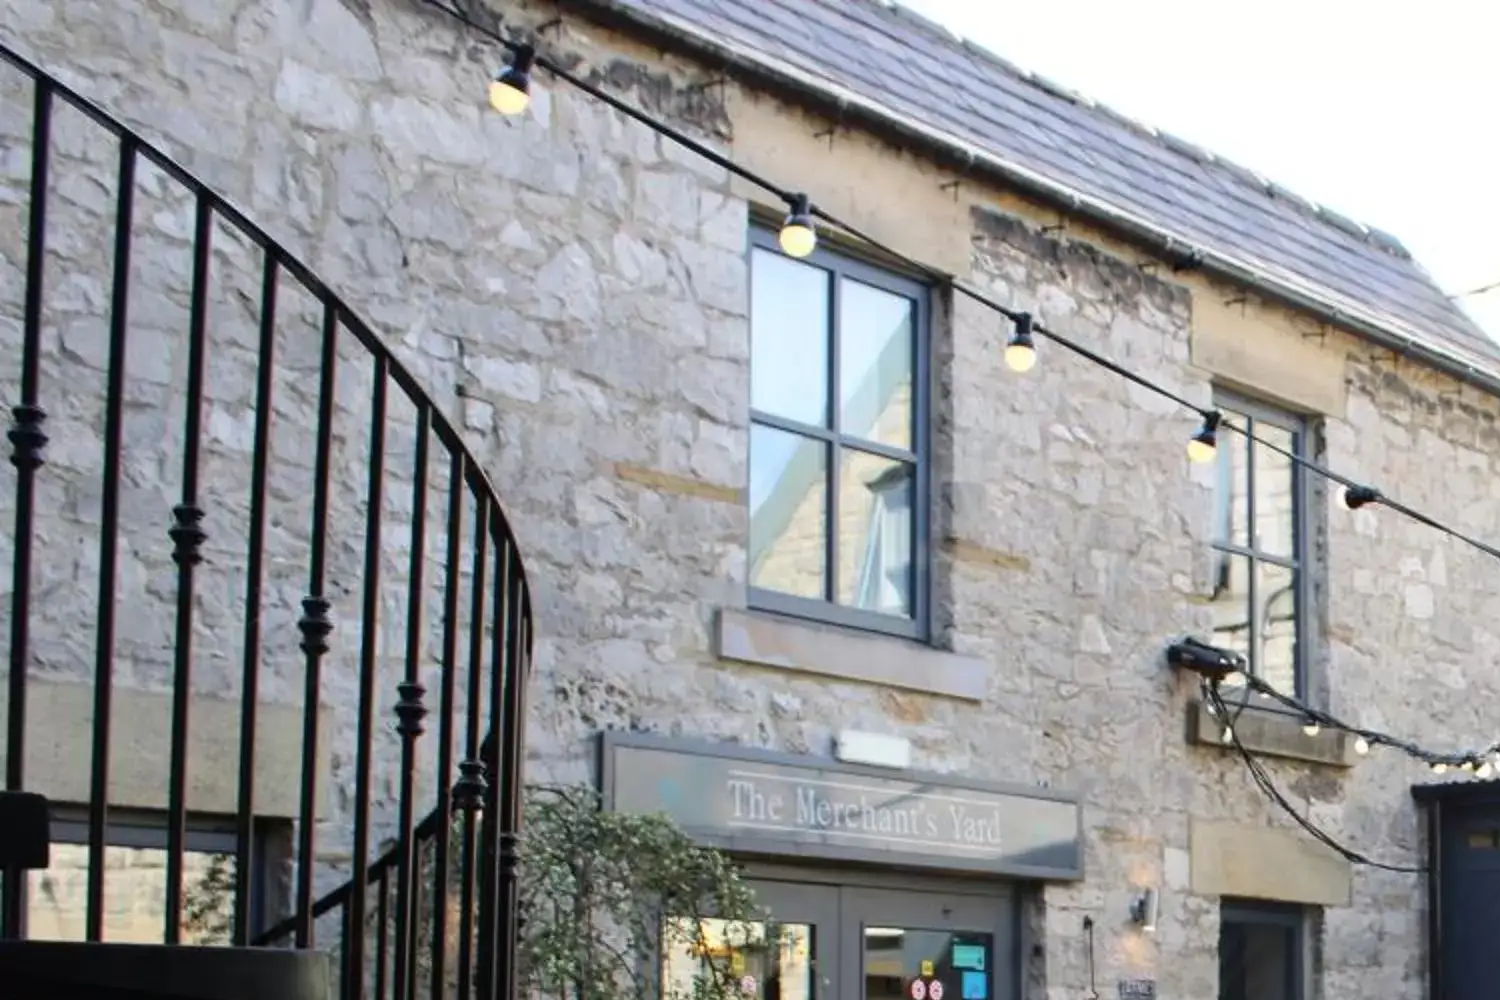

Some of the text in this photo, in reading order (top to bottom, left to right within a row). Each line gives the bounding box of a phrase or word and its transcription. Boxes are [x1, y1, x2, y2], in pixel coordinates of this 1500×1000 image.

[728, 780, 1002, 844] The Merchant's Yard
